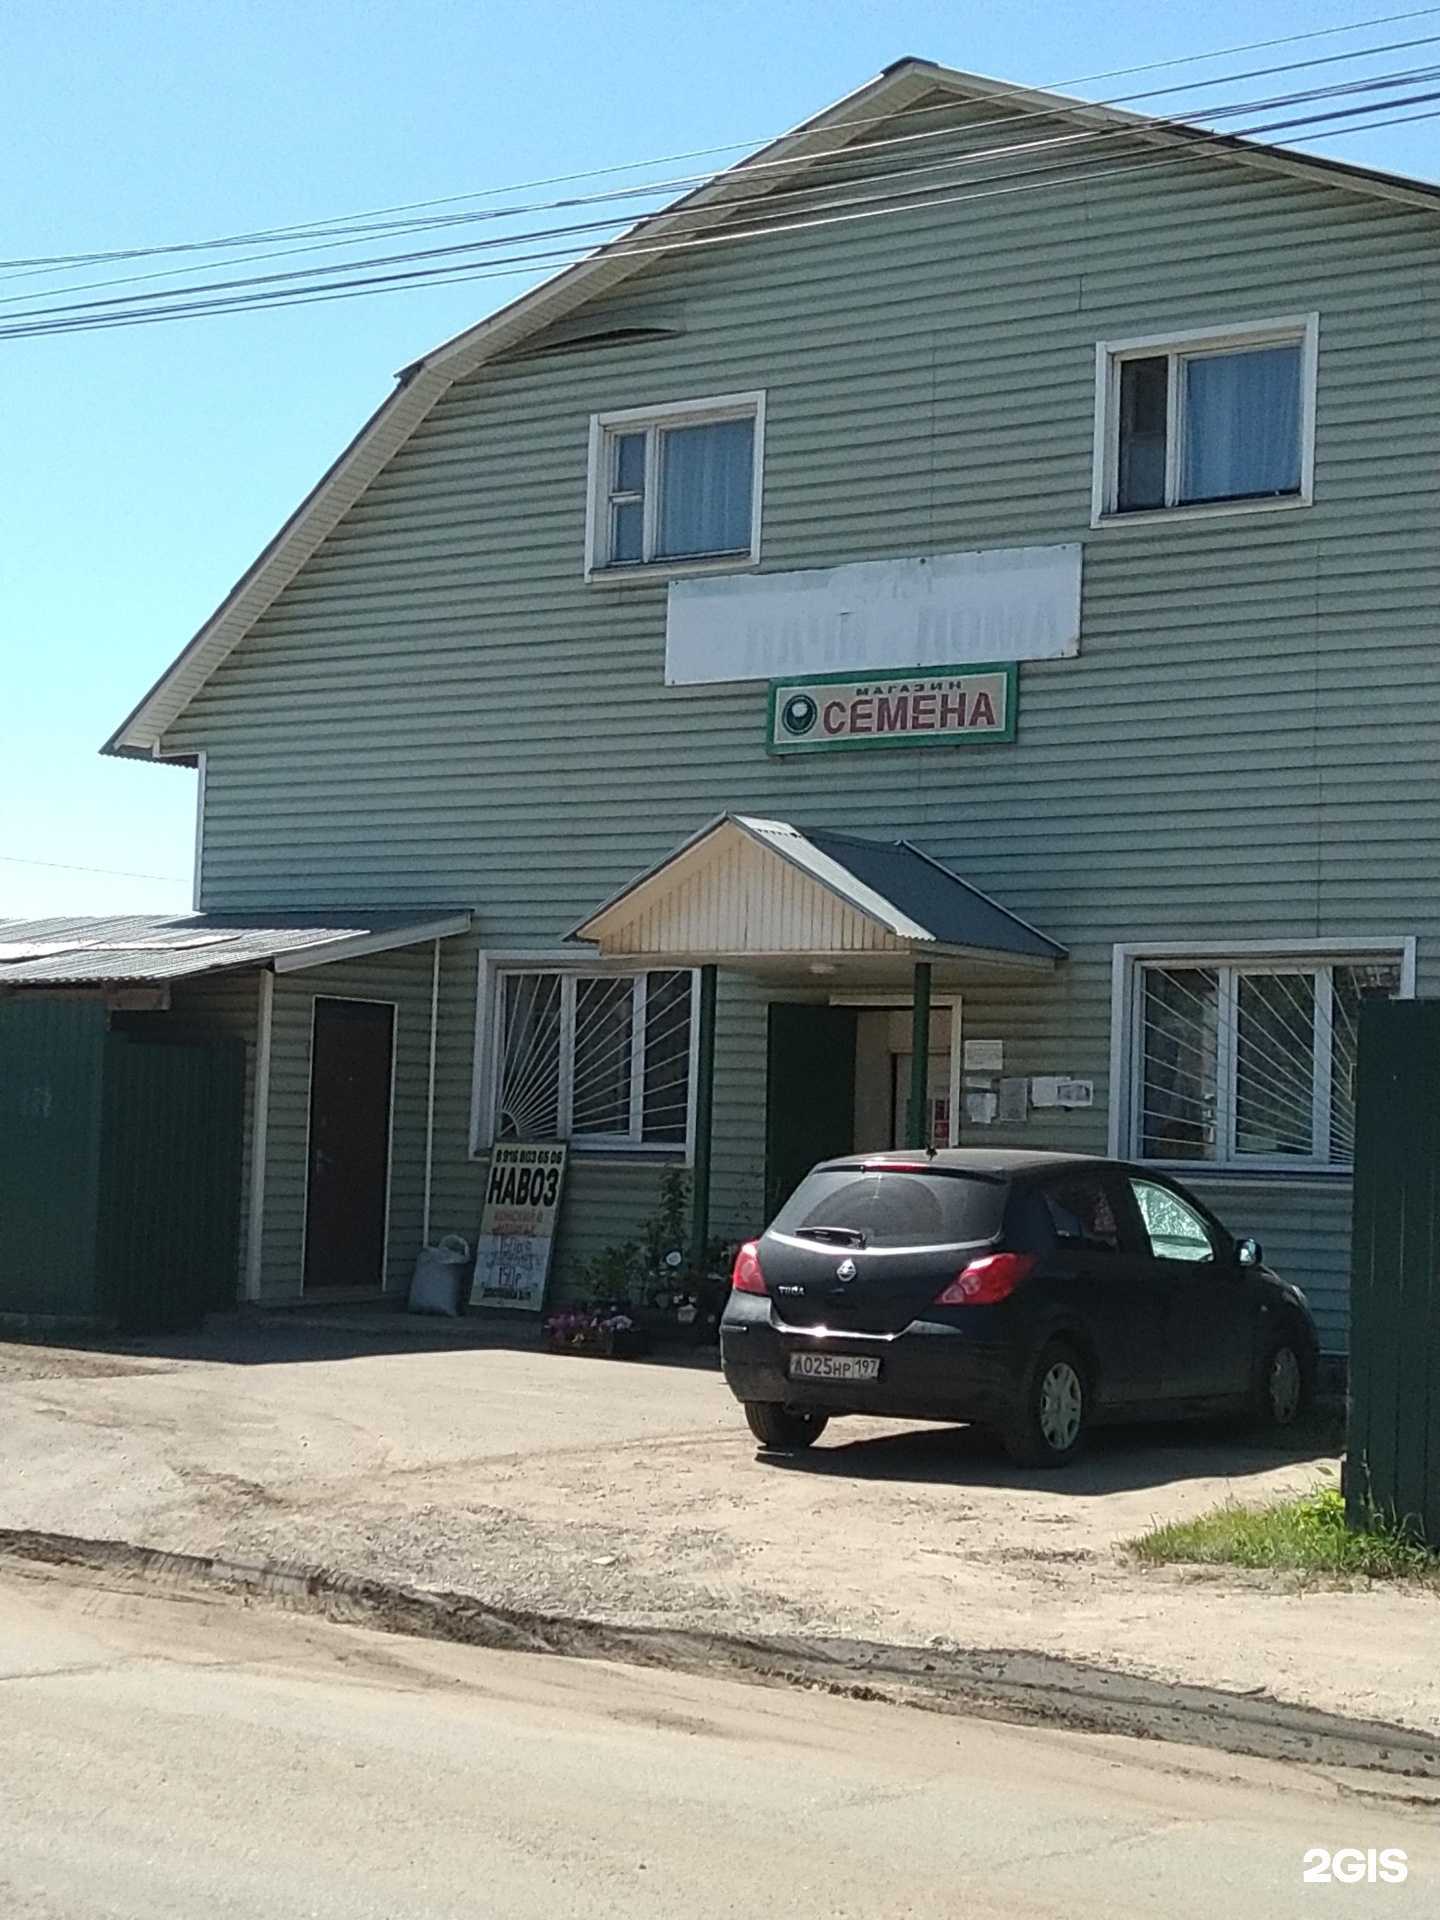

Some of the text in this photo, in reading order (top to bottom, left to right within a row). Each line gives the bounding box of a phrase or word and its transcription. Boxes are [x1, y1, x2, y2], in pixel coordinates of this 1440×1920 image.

[856, 680, 962, 696] МАГАЗИН
[823, 692, 995, 734] СЕМЕНА
[488, 1167, 559, 1207] НАВОЗ
[854, 1359, 877, 1375] 197
